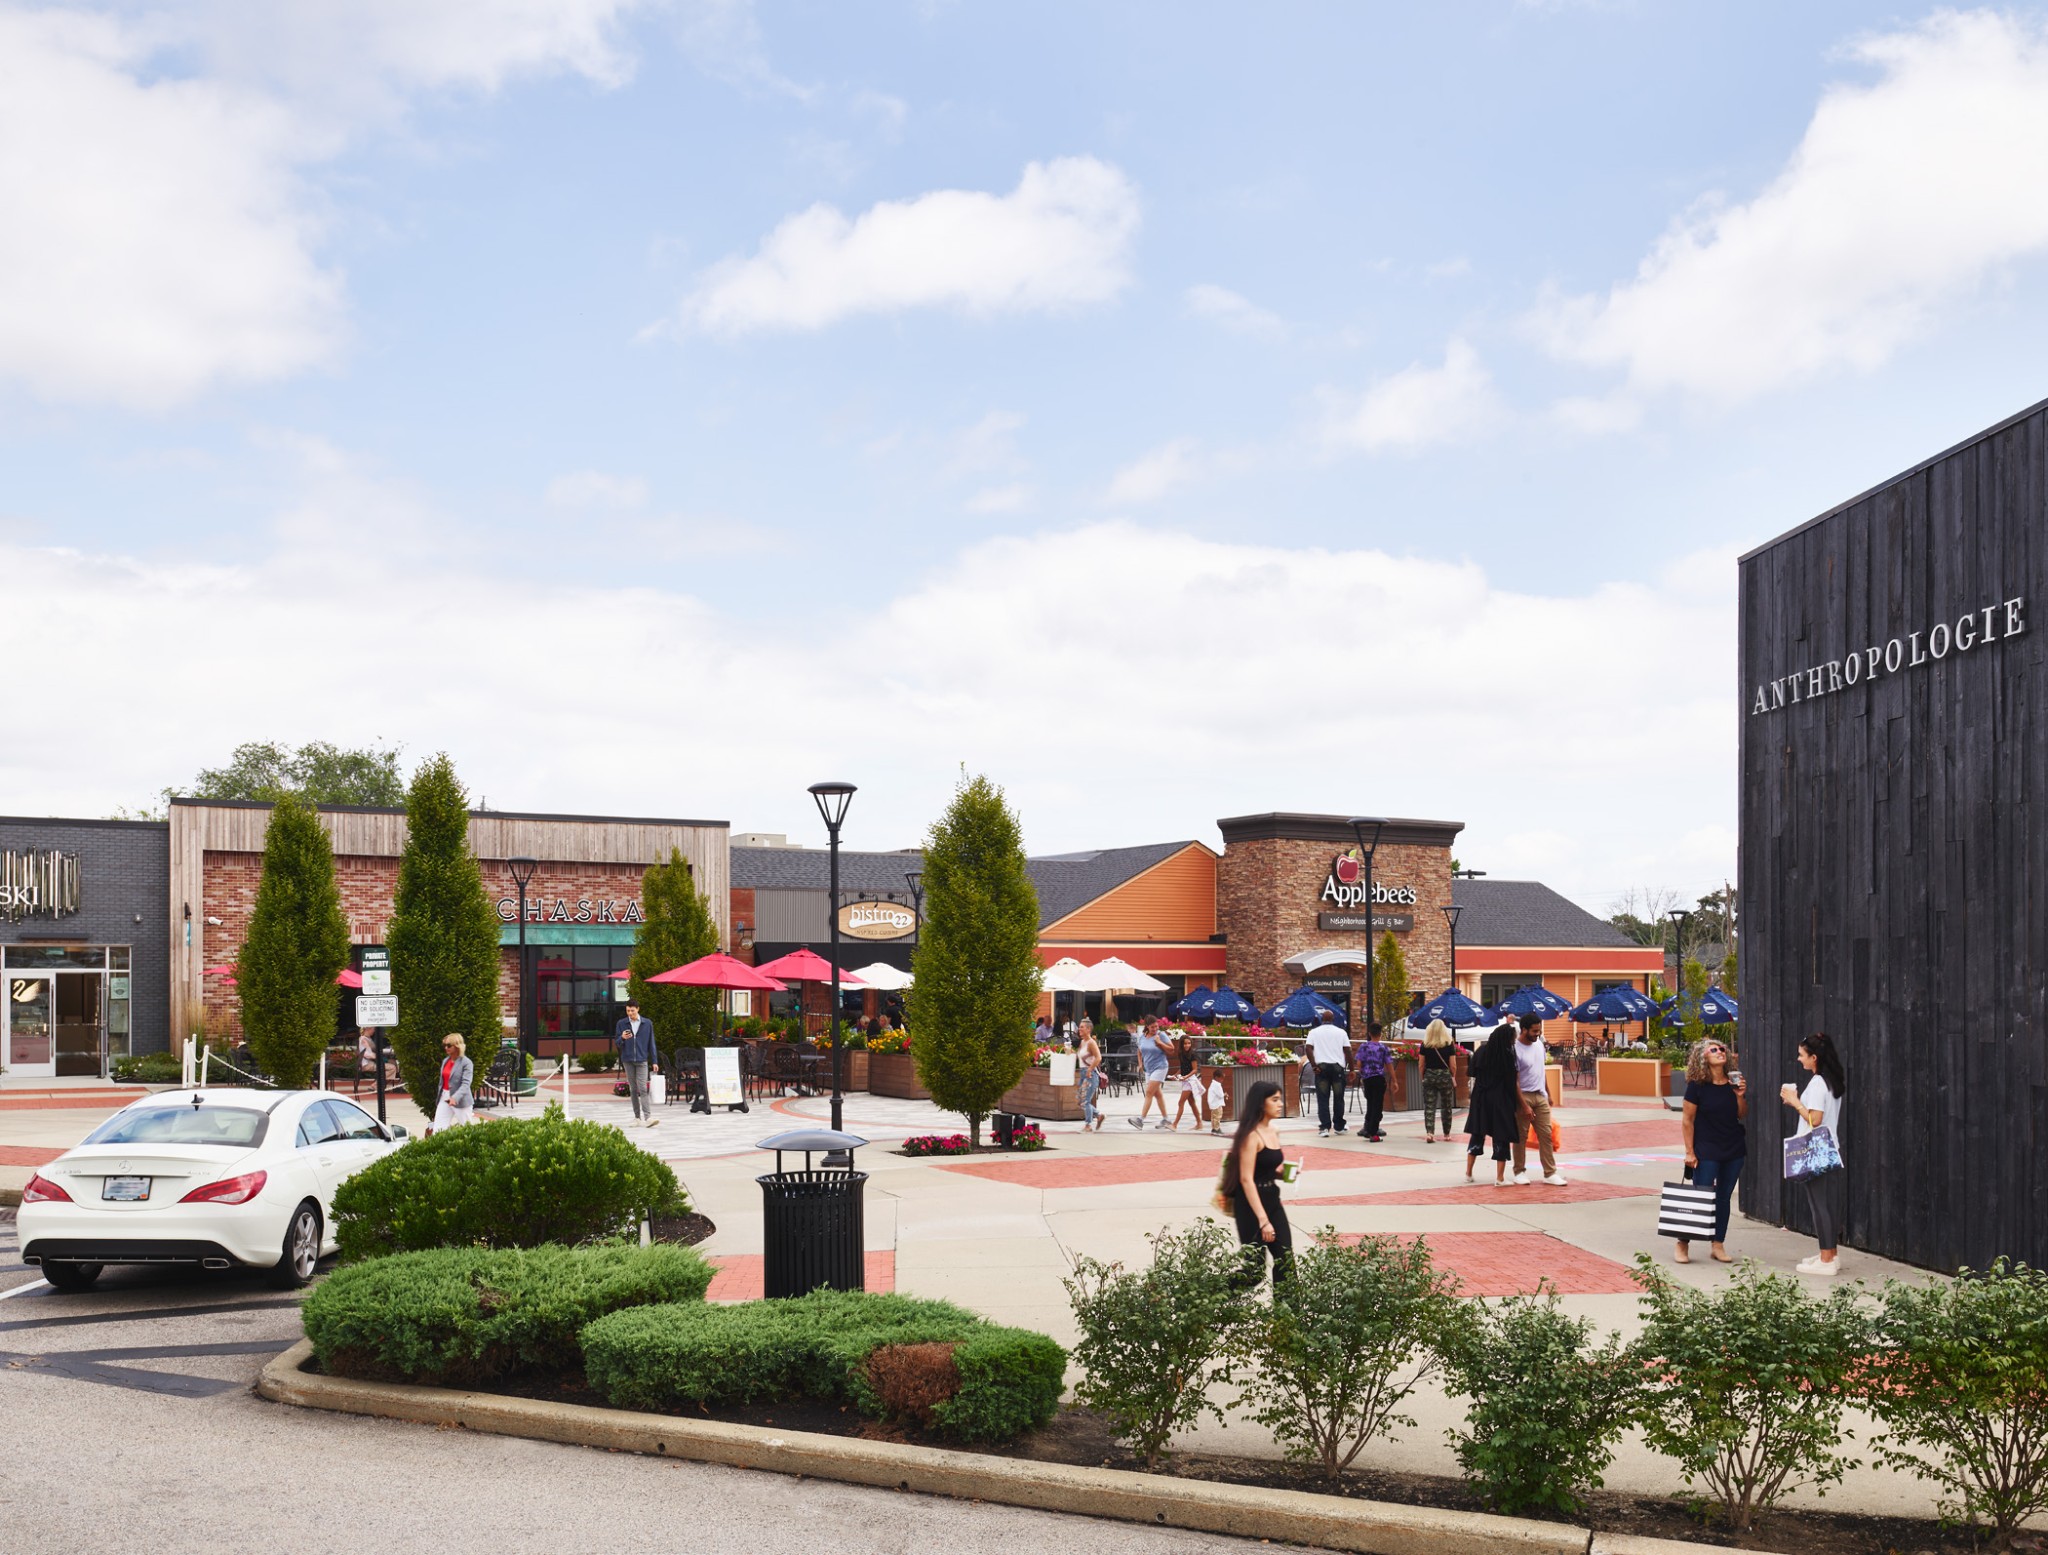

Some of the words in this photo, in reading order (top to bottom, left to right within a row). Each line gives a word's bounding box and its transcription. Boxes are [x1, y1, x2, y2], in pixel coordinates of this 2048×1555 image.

[1752, 596, 2026, 715] ANTHROPOLOGIE
[496, 897, 647, 922] CHASKA
[851, 905, 895, 921] bistro
[894, 915, 908, 926] 22
[1393, 918, 1405, 926] Bar
[363, 960, 388, 968] PROPERTY
